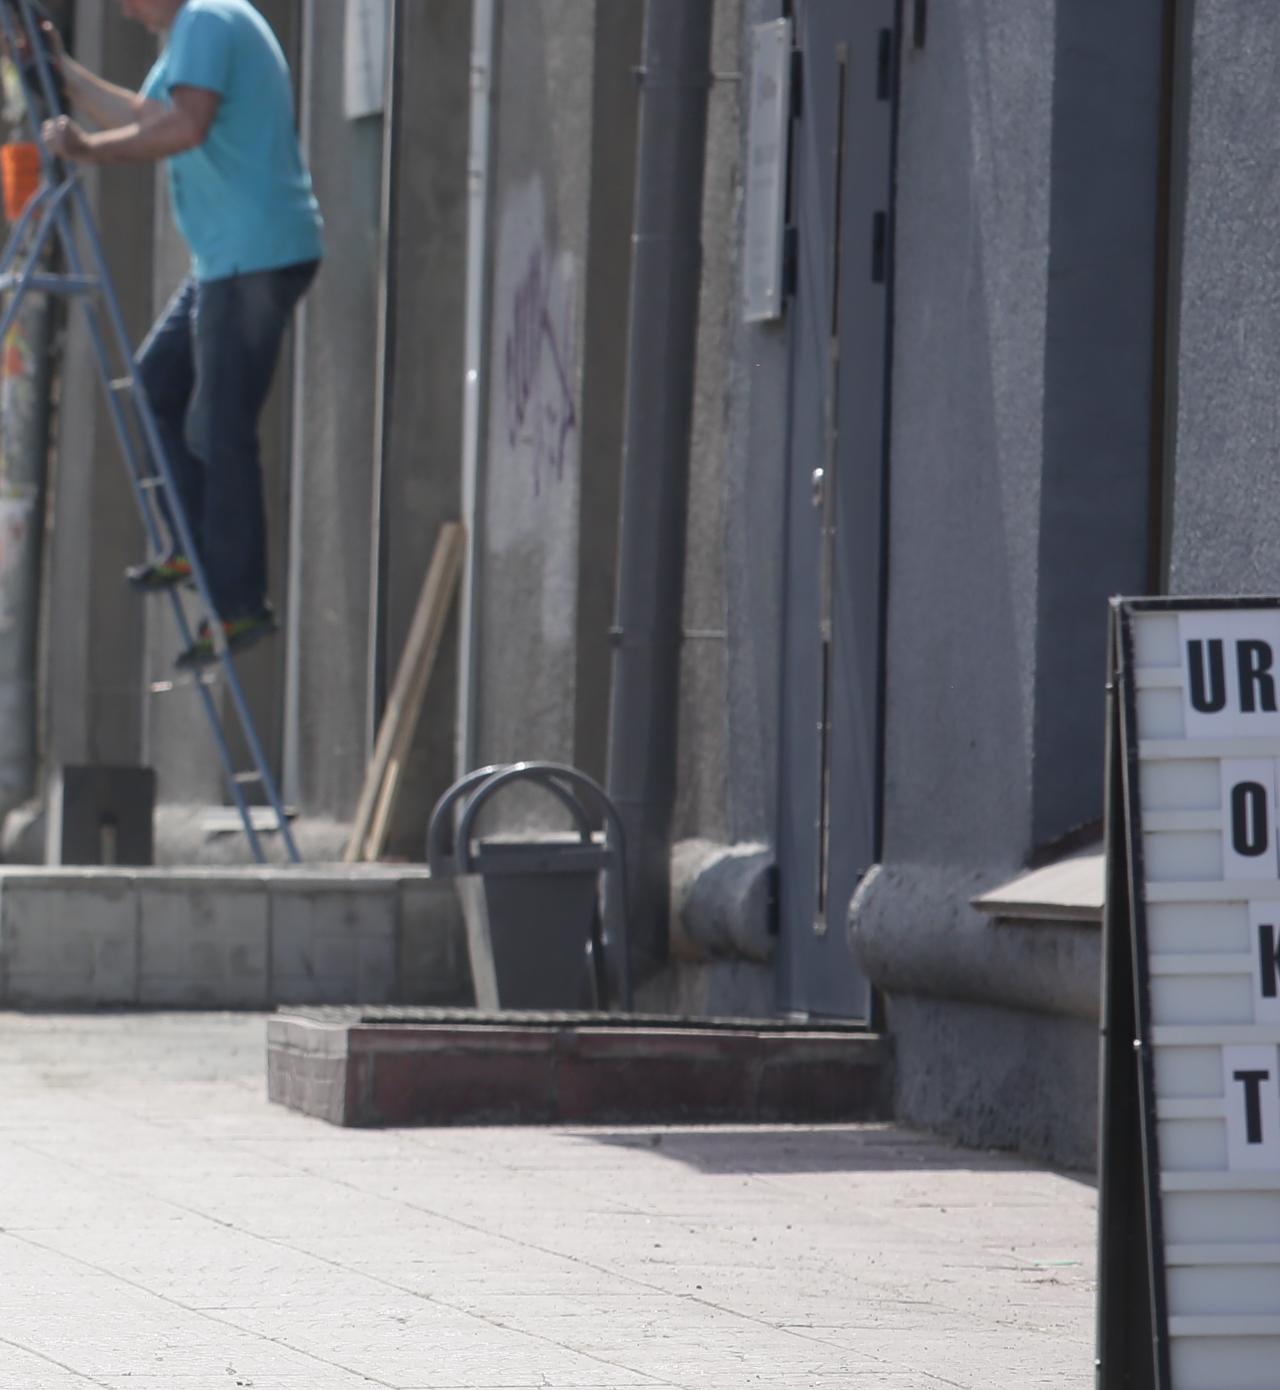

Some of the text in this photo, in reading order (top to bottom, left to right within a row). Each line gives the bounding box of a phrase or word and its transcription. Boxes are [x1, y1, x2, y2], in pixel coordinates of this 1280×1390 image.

[1186, 638, 1278, 714] UR
[1230, 781, 1268, 858] O
[1233, 1070, 1270, 1144] T
